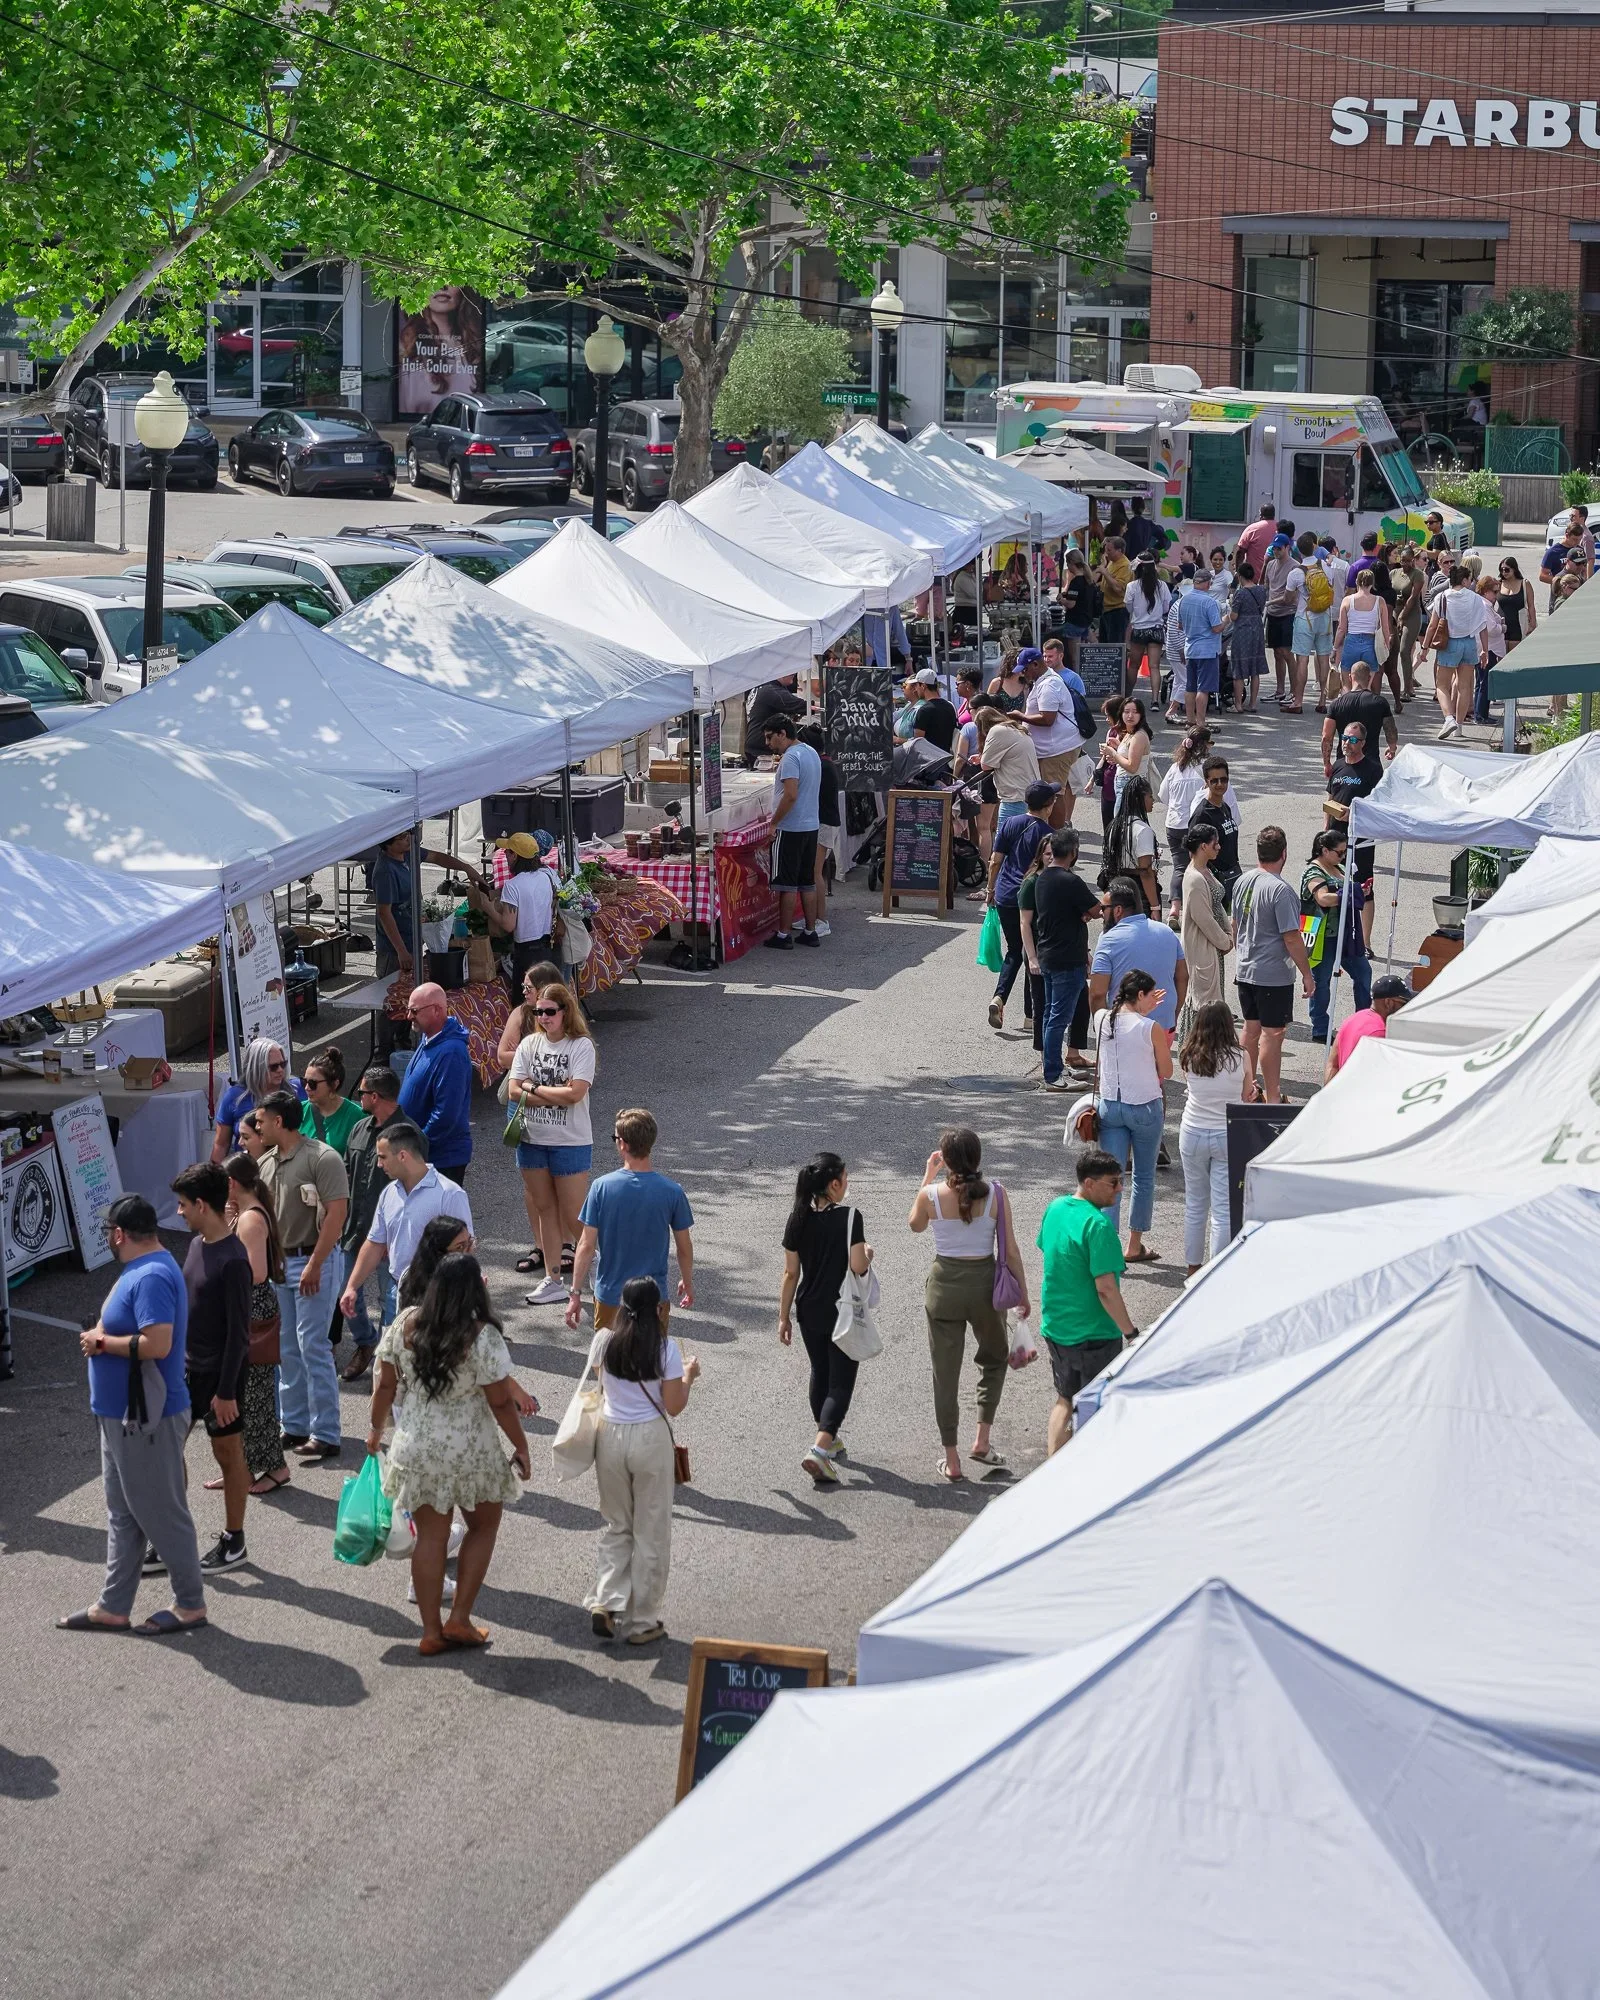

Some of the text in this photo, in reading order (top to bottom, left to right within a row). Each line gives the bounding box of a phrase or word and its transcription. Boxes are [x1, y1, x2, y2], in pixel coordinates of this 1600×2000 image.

[416, 341, 438, 356] Your
[402, 358, 477, 375] Hair Color Ever
[825, 394, 863, 404] AMHERST
[1304, 427, 1326, 439] Bowl
[841, 699, 876, 712] Jane
[842, 712, 880, 727] Wild
[837, 751, 883, 760] FOOD FOR THE
[842, 762, 884, 771] REBEL SOULS
[548, 1108, 568, 1120] SWIFT
